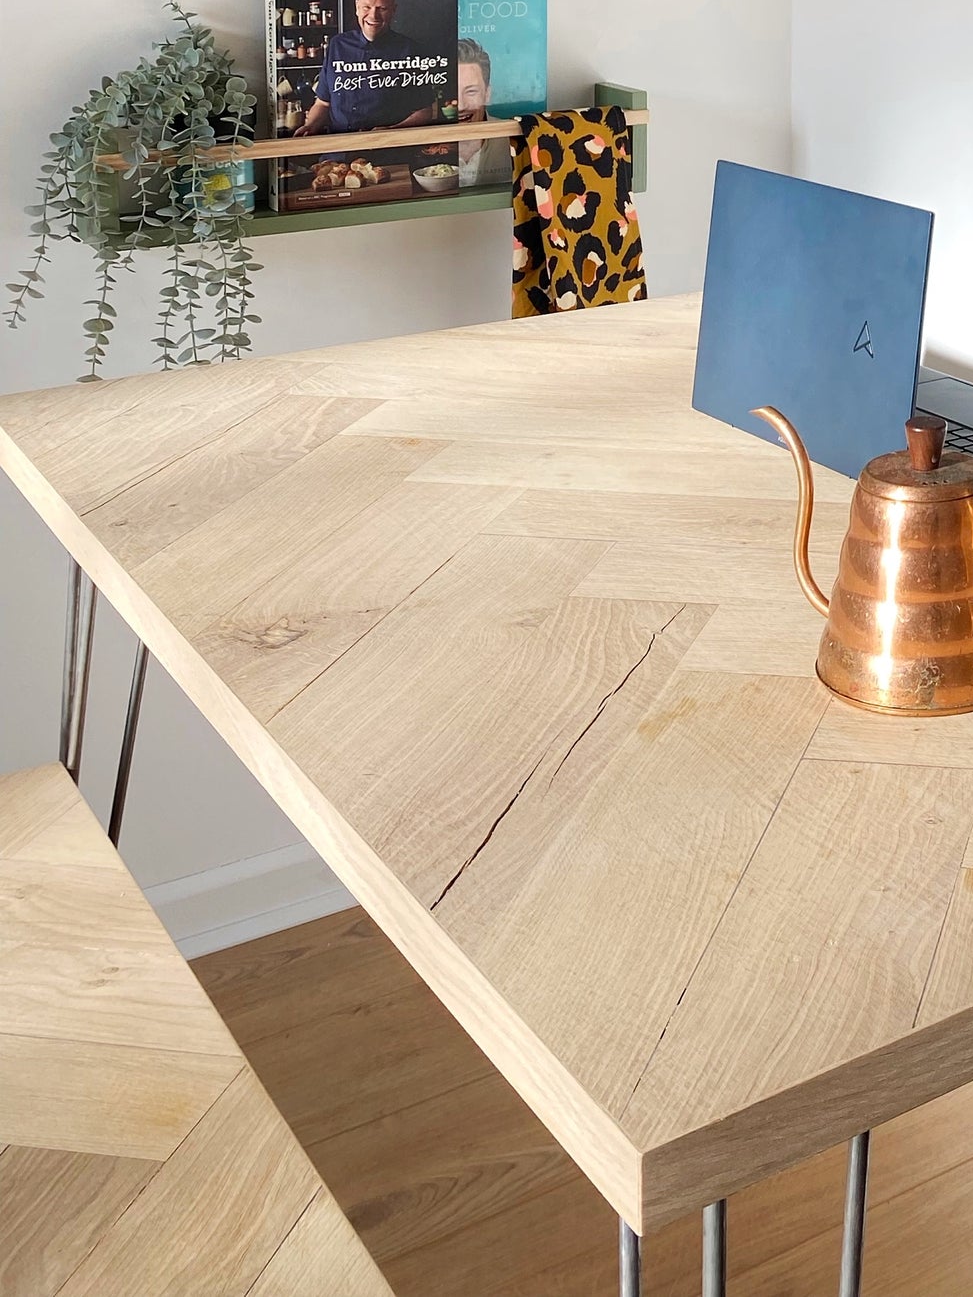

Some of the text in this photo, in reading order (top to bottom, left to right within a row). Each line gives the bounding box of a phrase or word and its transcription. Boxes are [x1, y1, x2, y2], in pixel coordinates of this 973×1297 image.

[469, 1, 528, 19] FOOD
[460, 24, 496, 33] OLIVER
[332, 55, 448, 73] Tom Kerridge's
[332, 71, 447, 92] Best Ever Dishes
